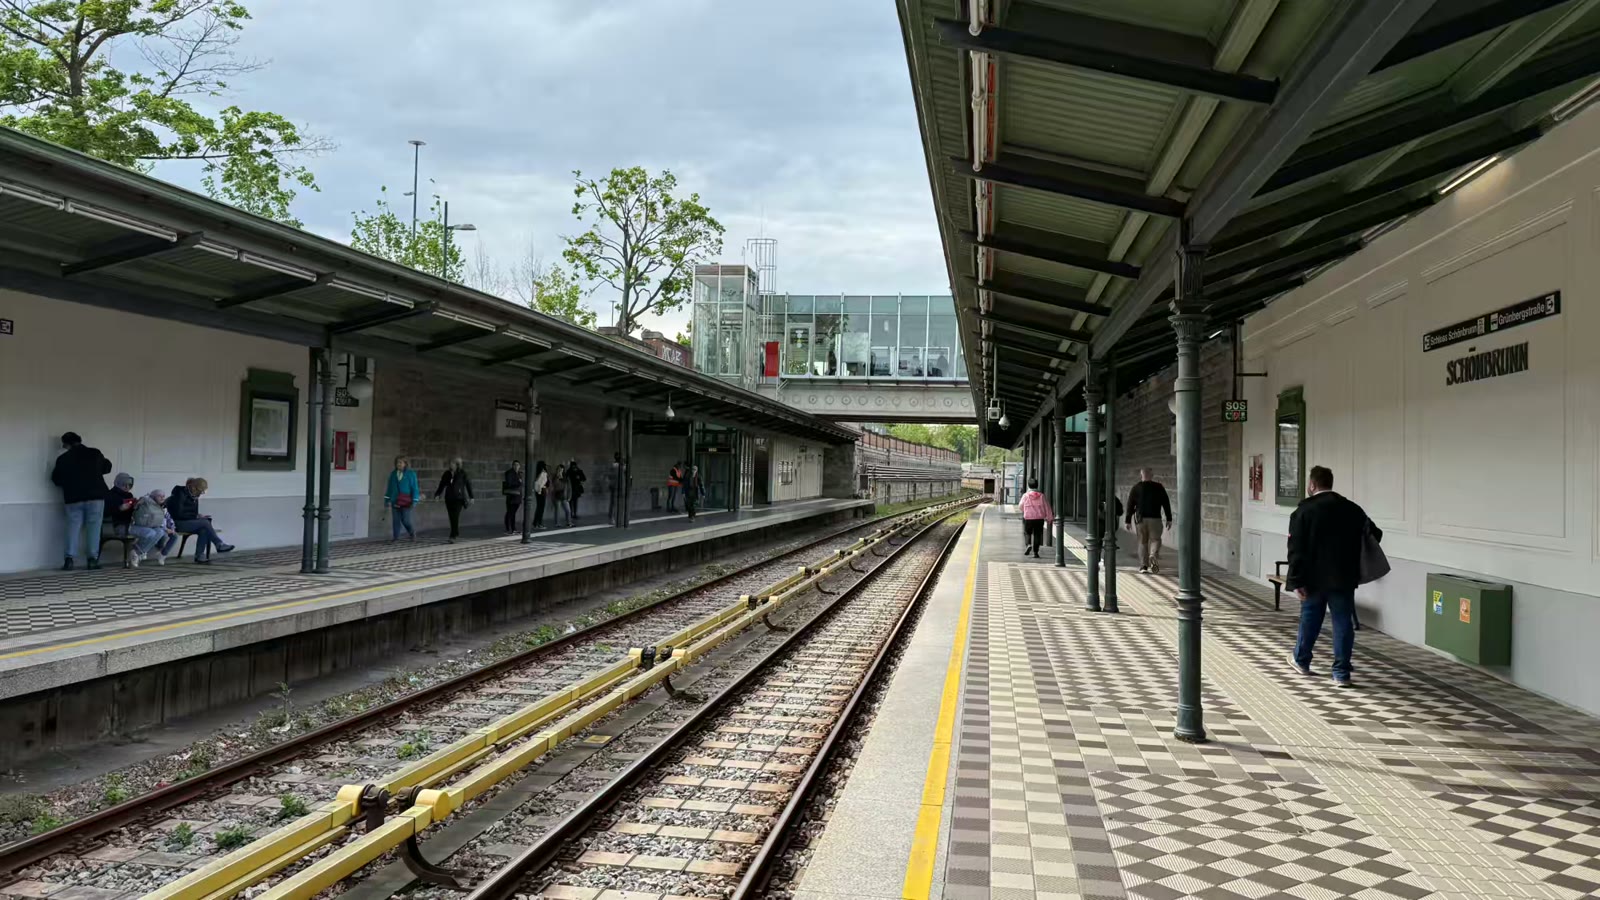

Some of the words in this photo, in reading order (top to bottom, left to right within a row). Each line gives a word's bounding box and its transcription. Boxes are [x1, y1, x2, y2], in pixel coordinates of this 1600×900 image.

[1498, 303, 1545, 325] Grünbergstraße
[1430, 334, 1448, 346] Schloss
[1448, 325, 1477, 341] Schönbrunn
[1446, 341, 1529, 386] SCHÖNBRUNN
[1225, 401, 1246, 410] SOS
